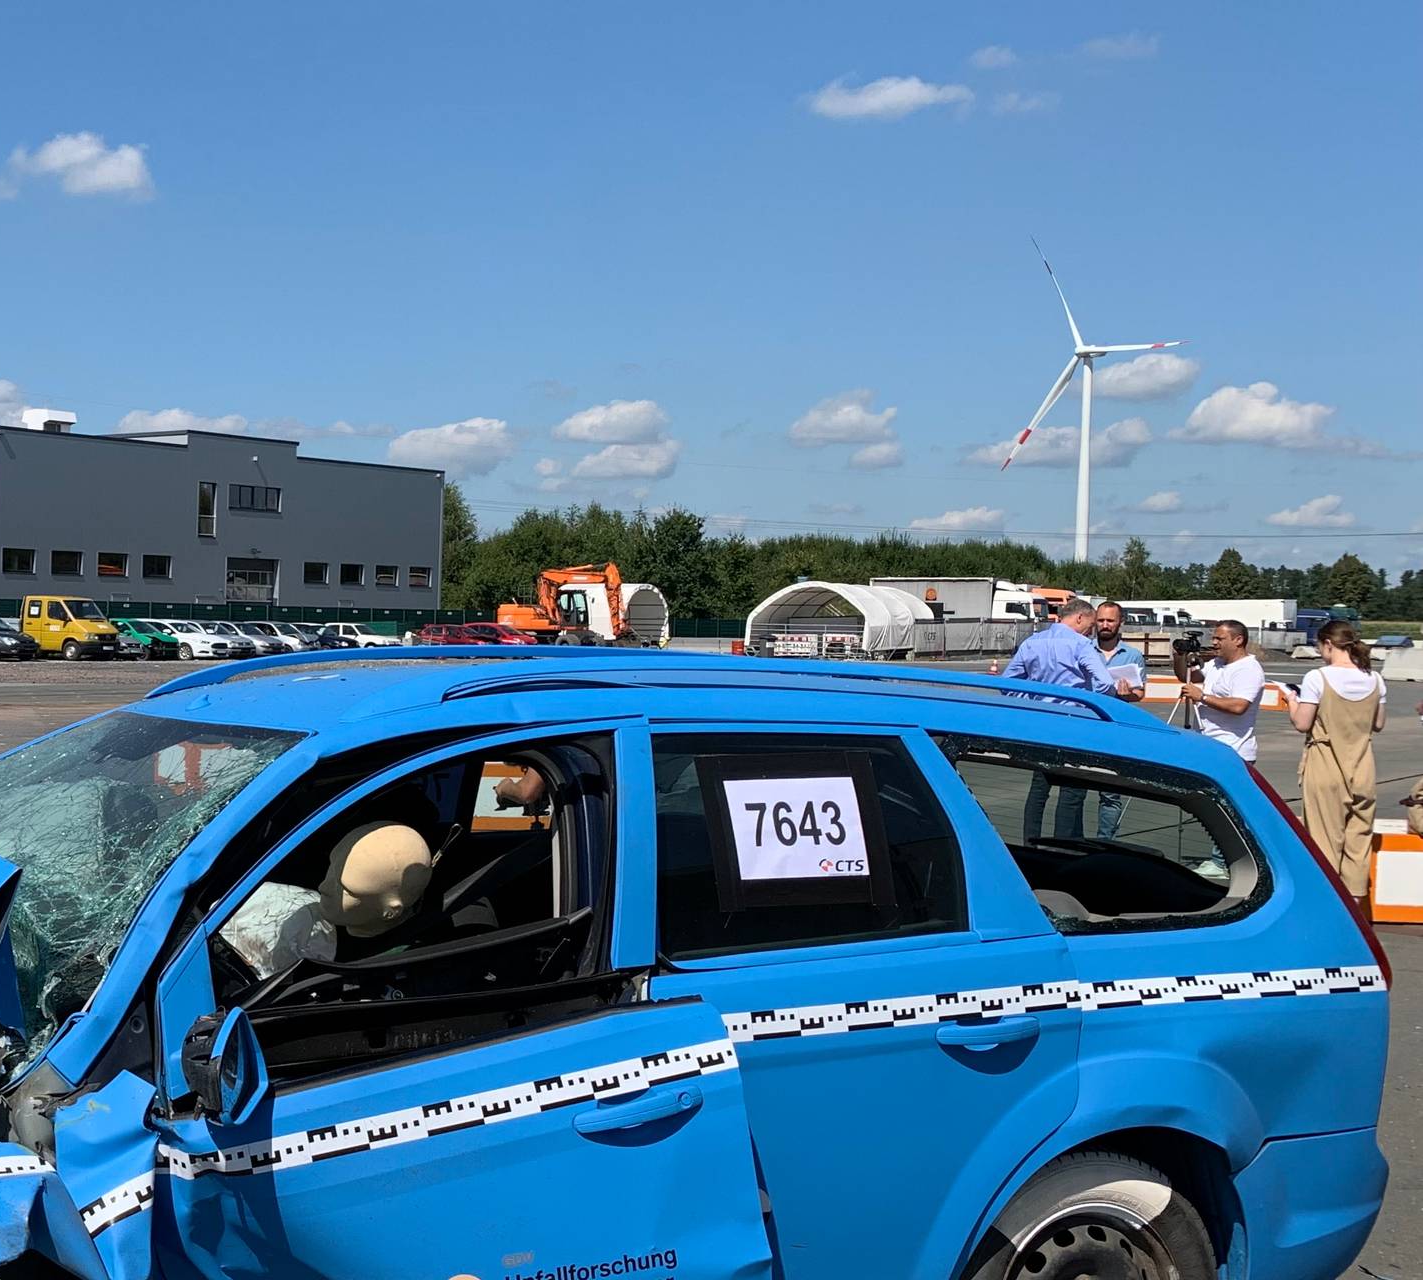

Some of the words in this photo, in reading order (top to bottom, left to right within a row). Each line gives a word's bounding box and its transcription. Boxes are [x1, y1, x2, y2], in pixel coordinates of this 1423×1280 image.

[744, 800, 846, 847] 7643
[835, 859, 864, 872] CTS
[505, 1249, 677, 1280] fallforschung
